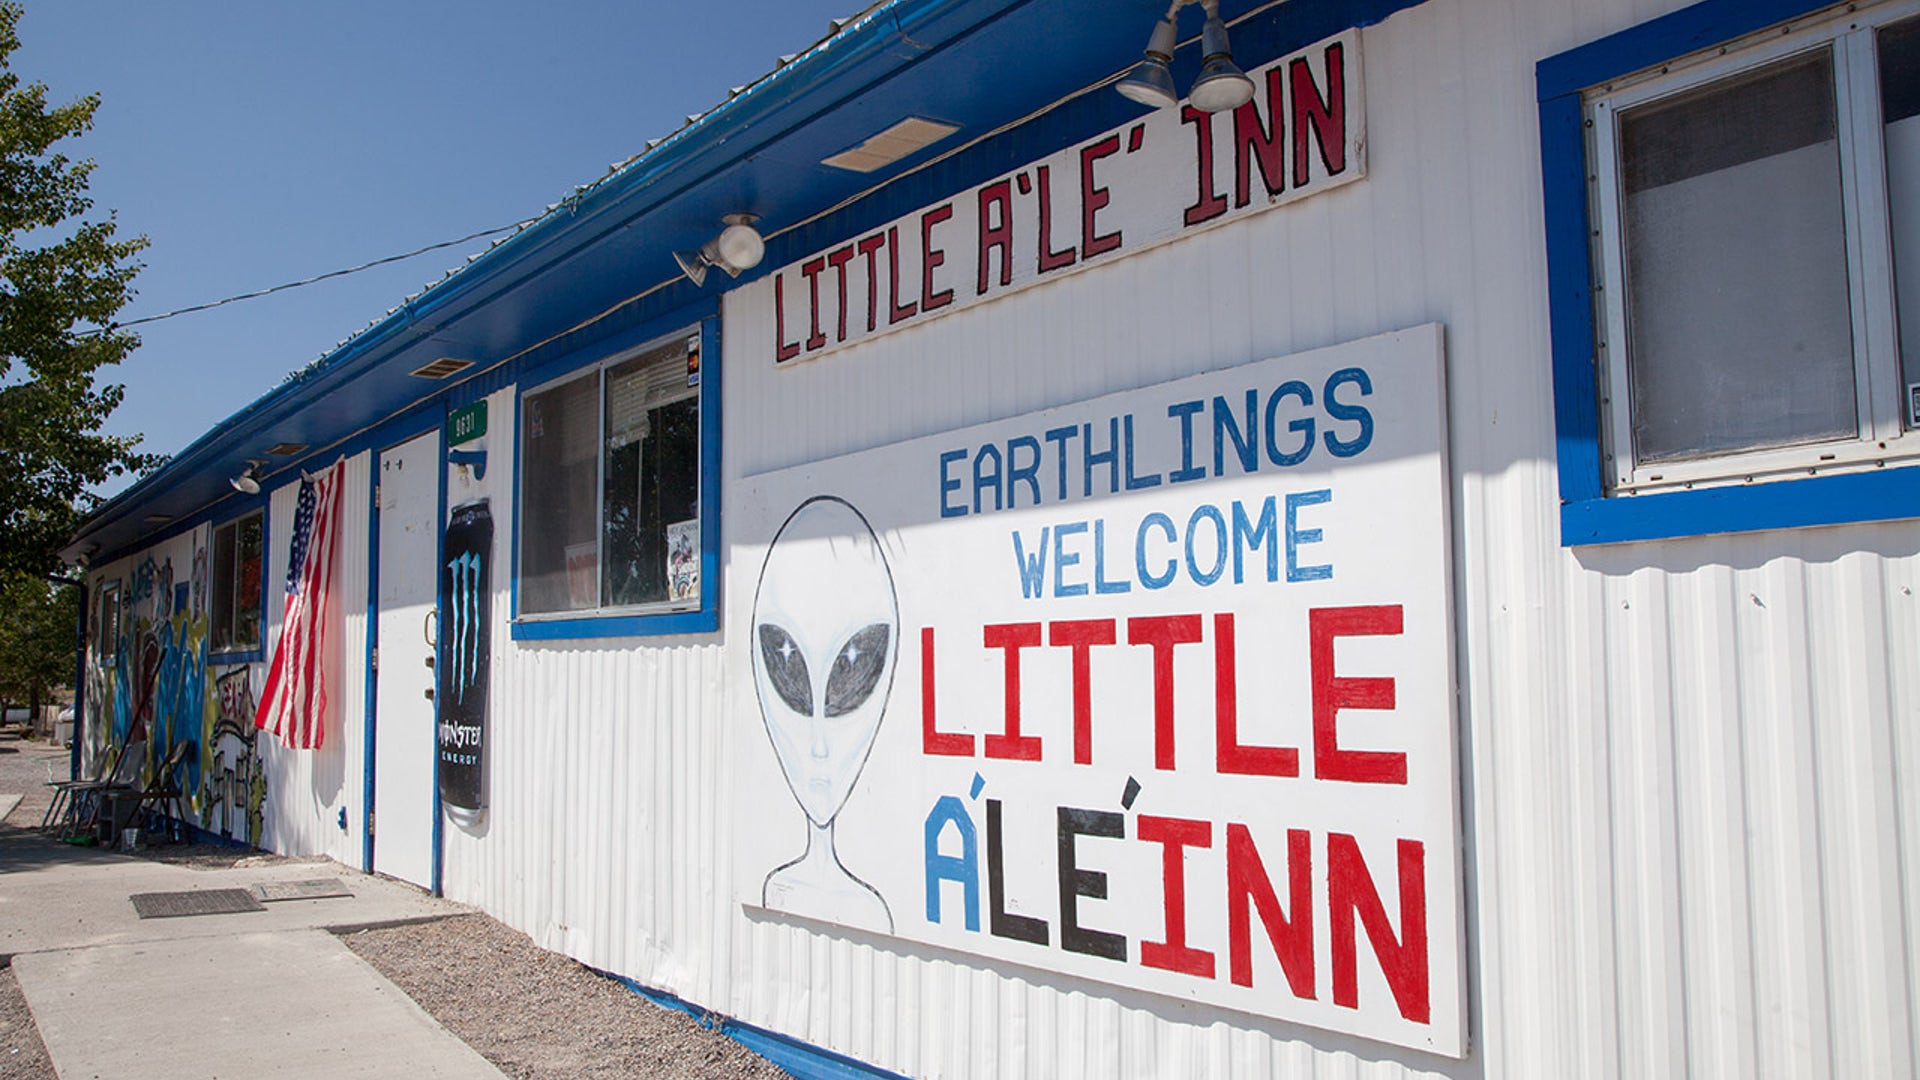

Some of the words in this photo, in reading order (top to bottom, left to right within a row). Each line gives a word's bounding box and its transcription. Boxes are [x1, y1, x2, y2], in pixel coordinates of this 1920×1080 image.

[776, 204, 953, 362] LITTLE
[1181, 41, 1346, 227] INN
[939, 367, 1375, 519] EARTHLINGS
[1012, 489, 1333, 599] WELCOME
[442, 750, 477, 765] ENERGY
[921, 604, 1408, 785] LITTLE
